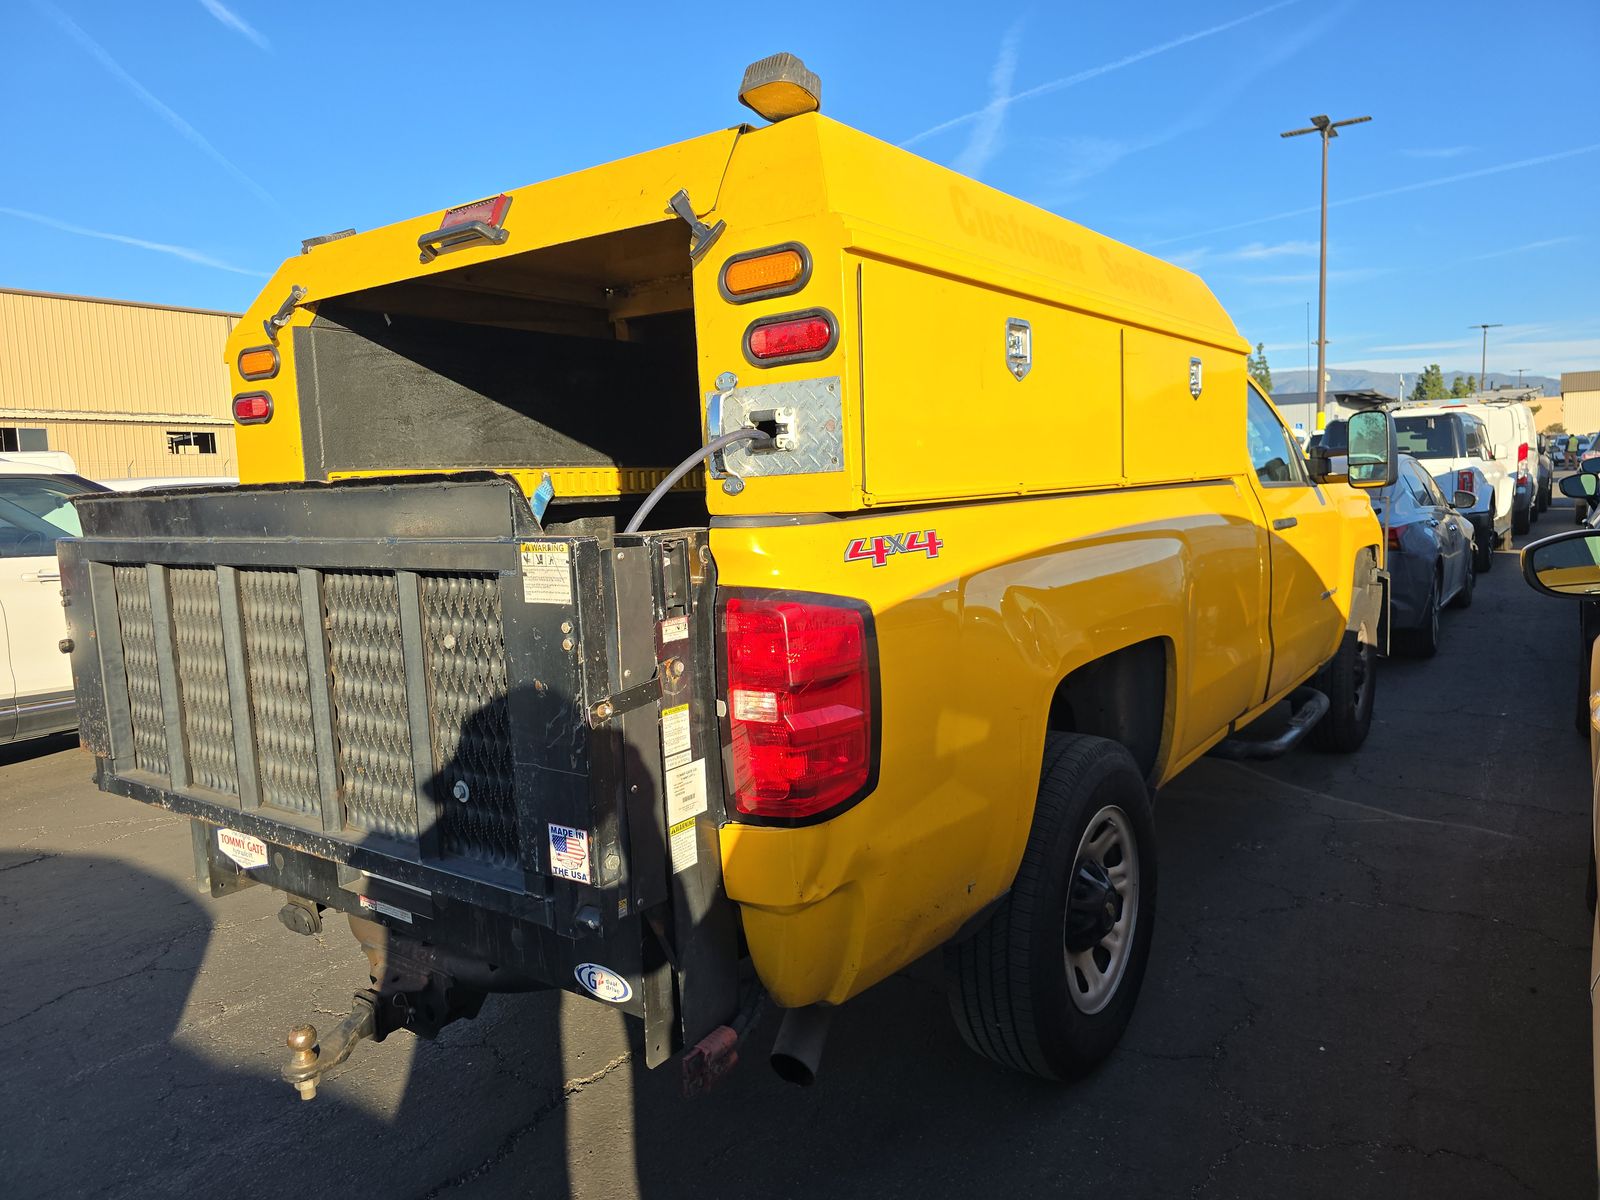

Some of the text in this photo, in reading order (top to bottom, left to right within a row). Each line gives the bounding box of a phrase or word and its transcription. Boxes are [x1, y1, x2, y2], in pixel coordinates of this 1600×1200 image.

[551, 826, 585, 840] MADE IN
[220, 833, 245, 850] TOMMY
[246, 841, 265, 856] GATE
[553, 866, 588, 882] THE USA
